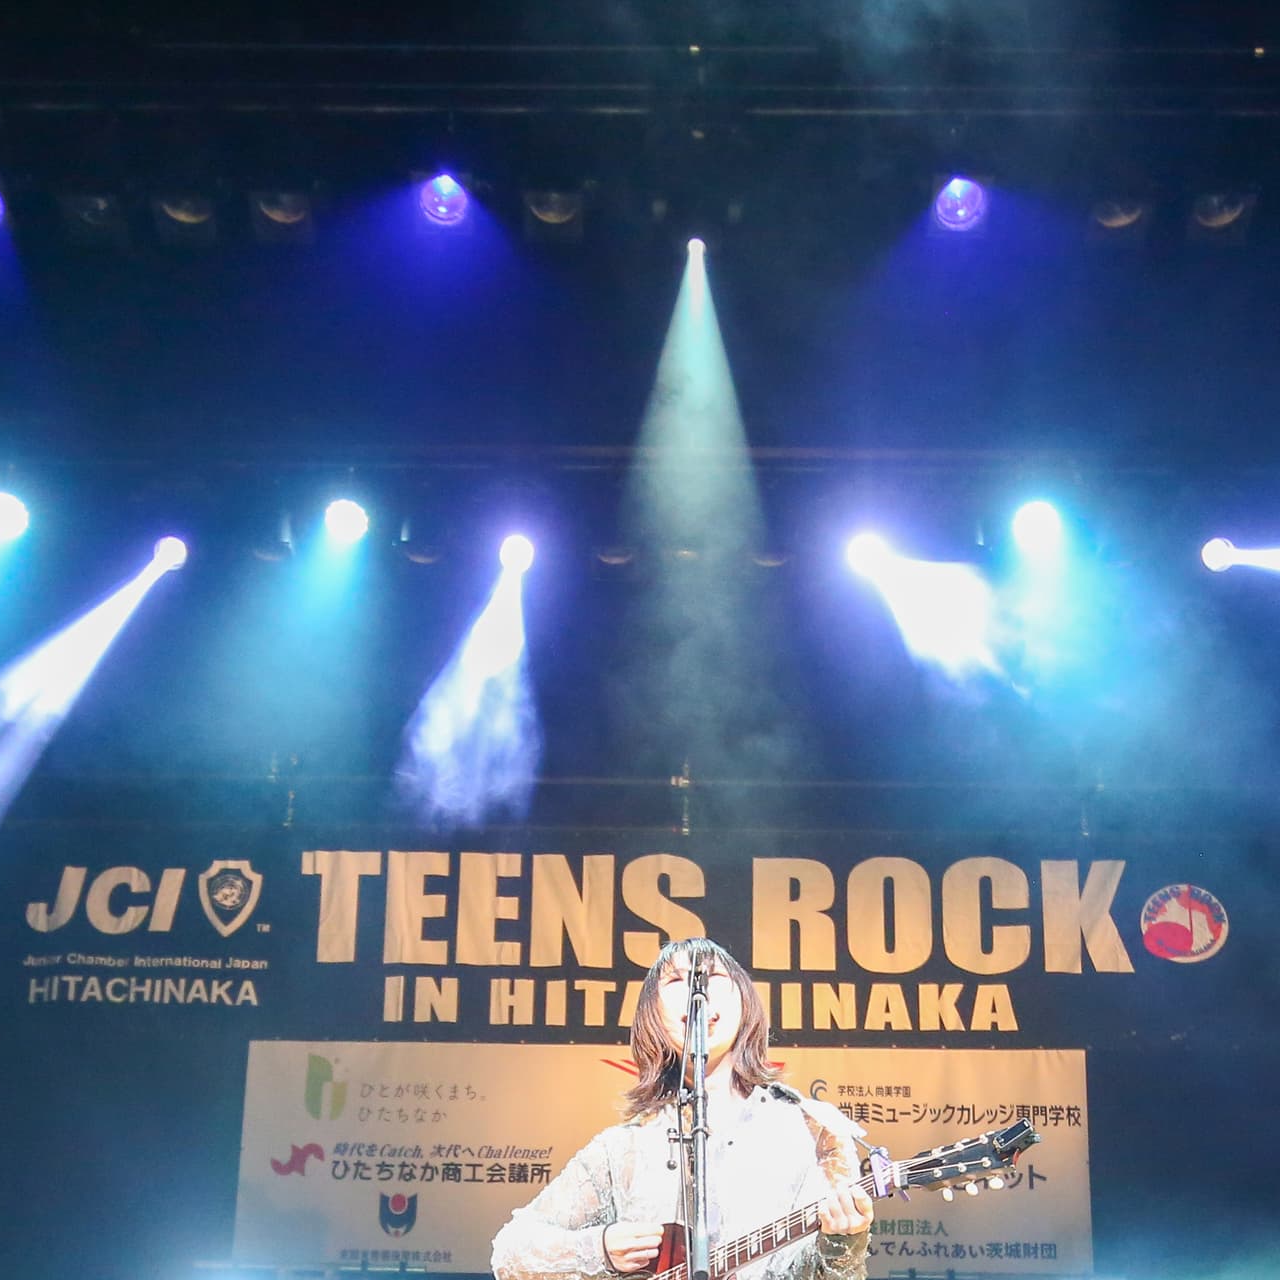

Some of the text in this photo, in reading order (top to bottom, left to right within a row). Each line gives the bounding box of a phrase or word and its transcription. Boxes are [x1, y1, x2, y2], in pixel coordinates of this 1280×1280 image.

[25, 866, 187, 935] JCI
[301, 851, 1135, 974] TEENS ROCK
[134, 955, 221, 969] International
[226, 957, 268, 970] Japan
[28, 976, 258, 1006] HITACHINAKA
[384, 975, 458, 1023] IN
[357, 1106, 447, 1123] ひたちなか
[331, 1159, 553, 1184] ひたちなか商工会議所
